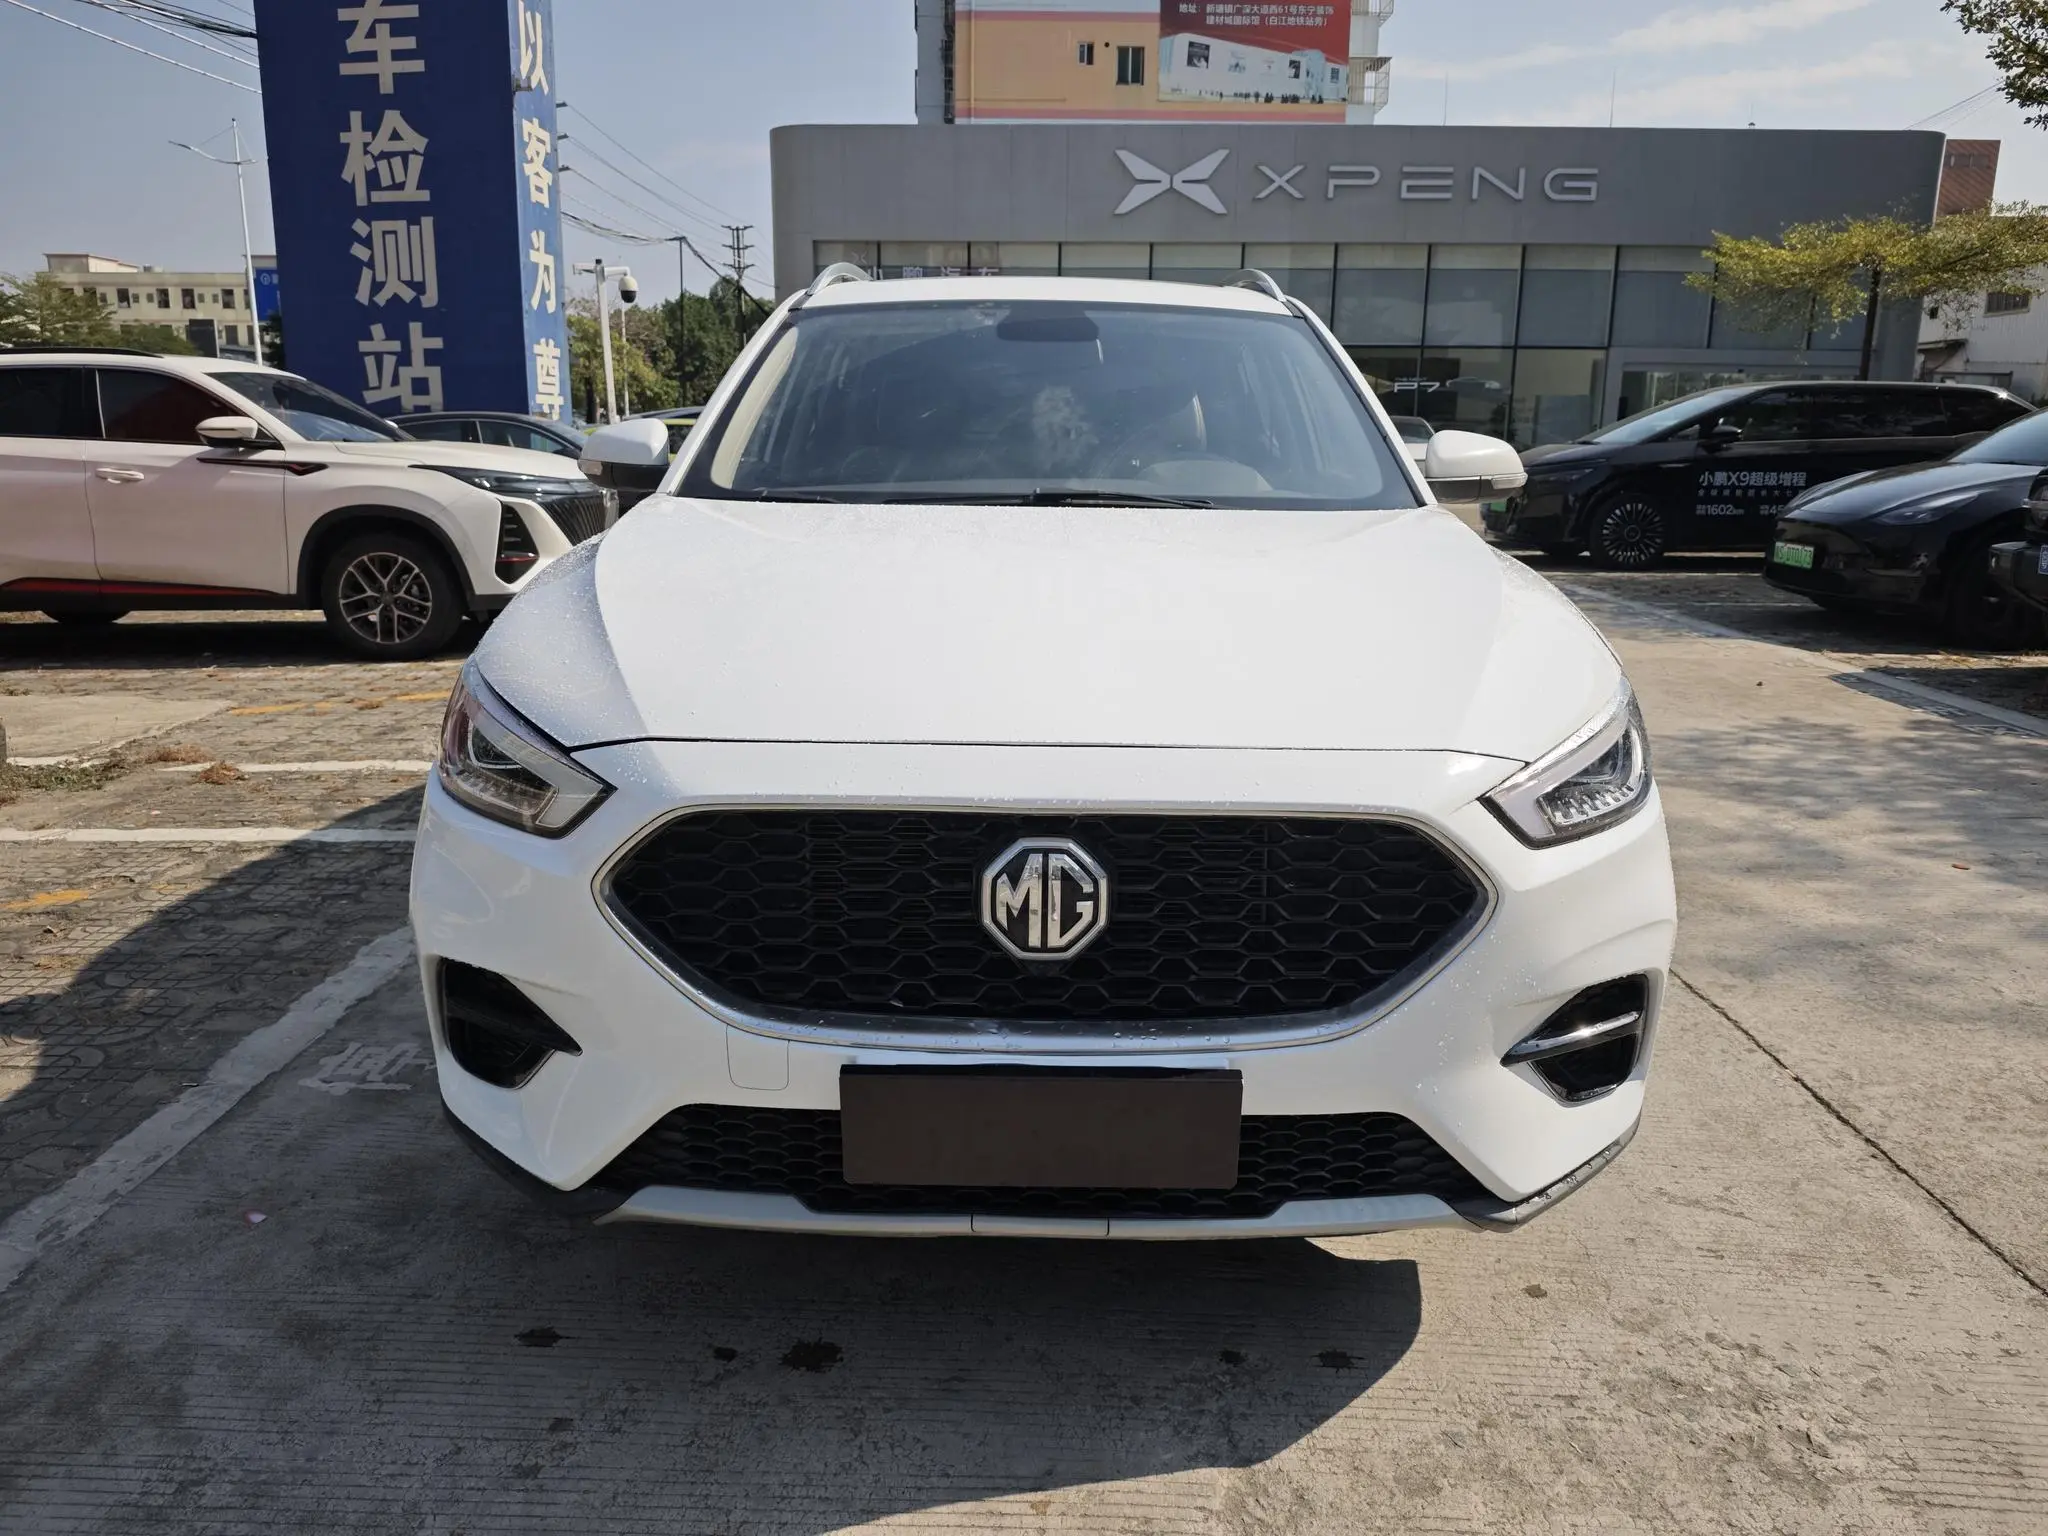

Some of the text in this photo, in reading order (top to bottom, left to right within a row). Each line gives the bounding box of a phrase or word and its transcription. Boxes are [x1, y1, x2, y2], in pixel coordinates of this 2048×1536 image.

[338, 0, 445, 412] 车检测站
[517, 0, 565, 421] 以客为尊
[1254, 164, 1599, 201] XPENG
[1394, 382, 1440, 393] P7
[1699, 471, 1807, 487] 小鹏X9超级增程
[995, 852, 1094, 949] MG
